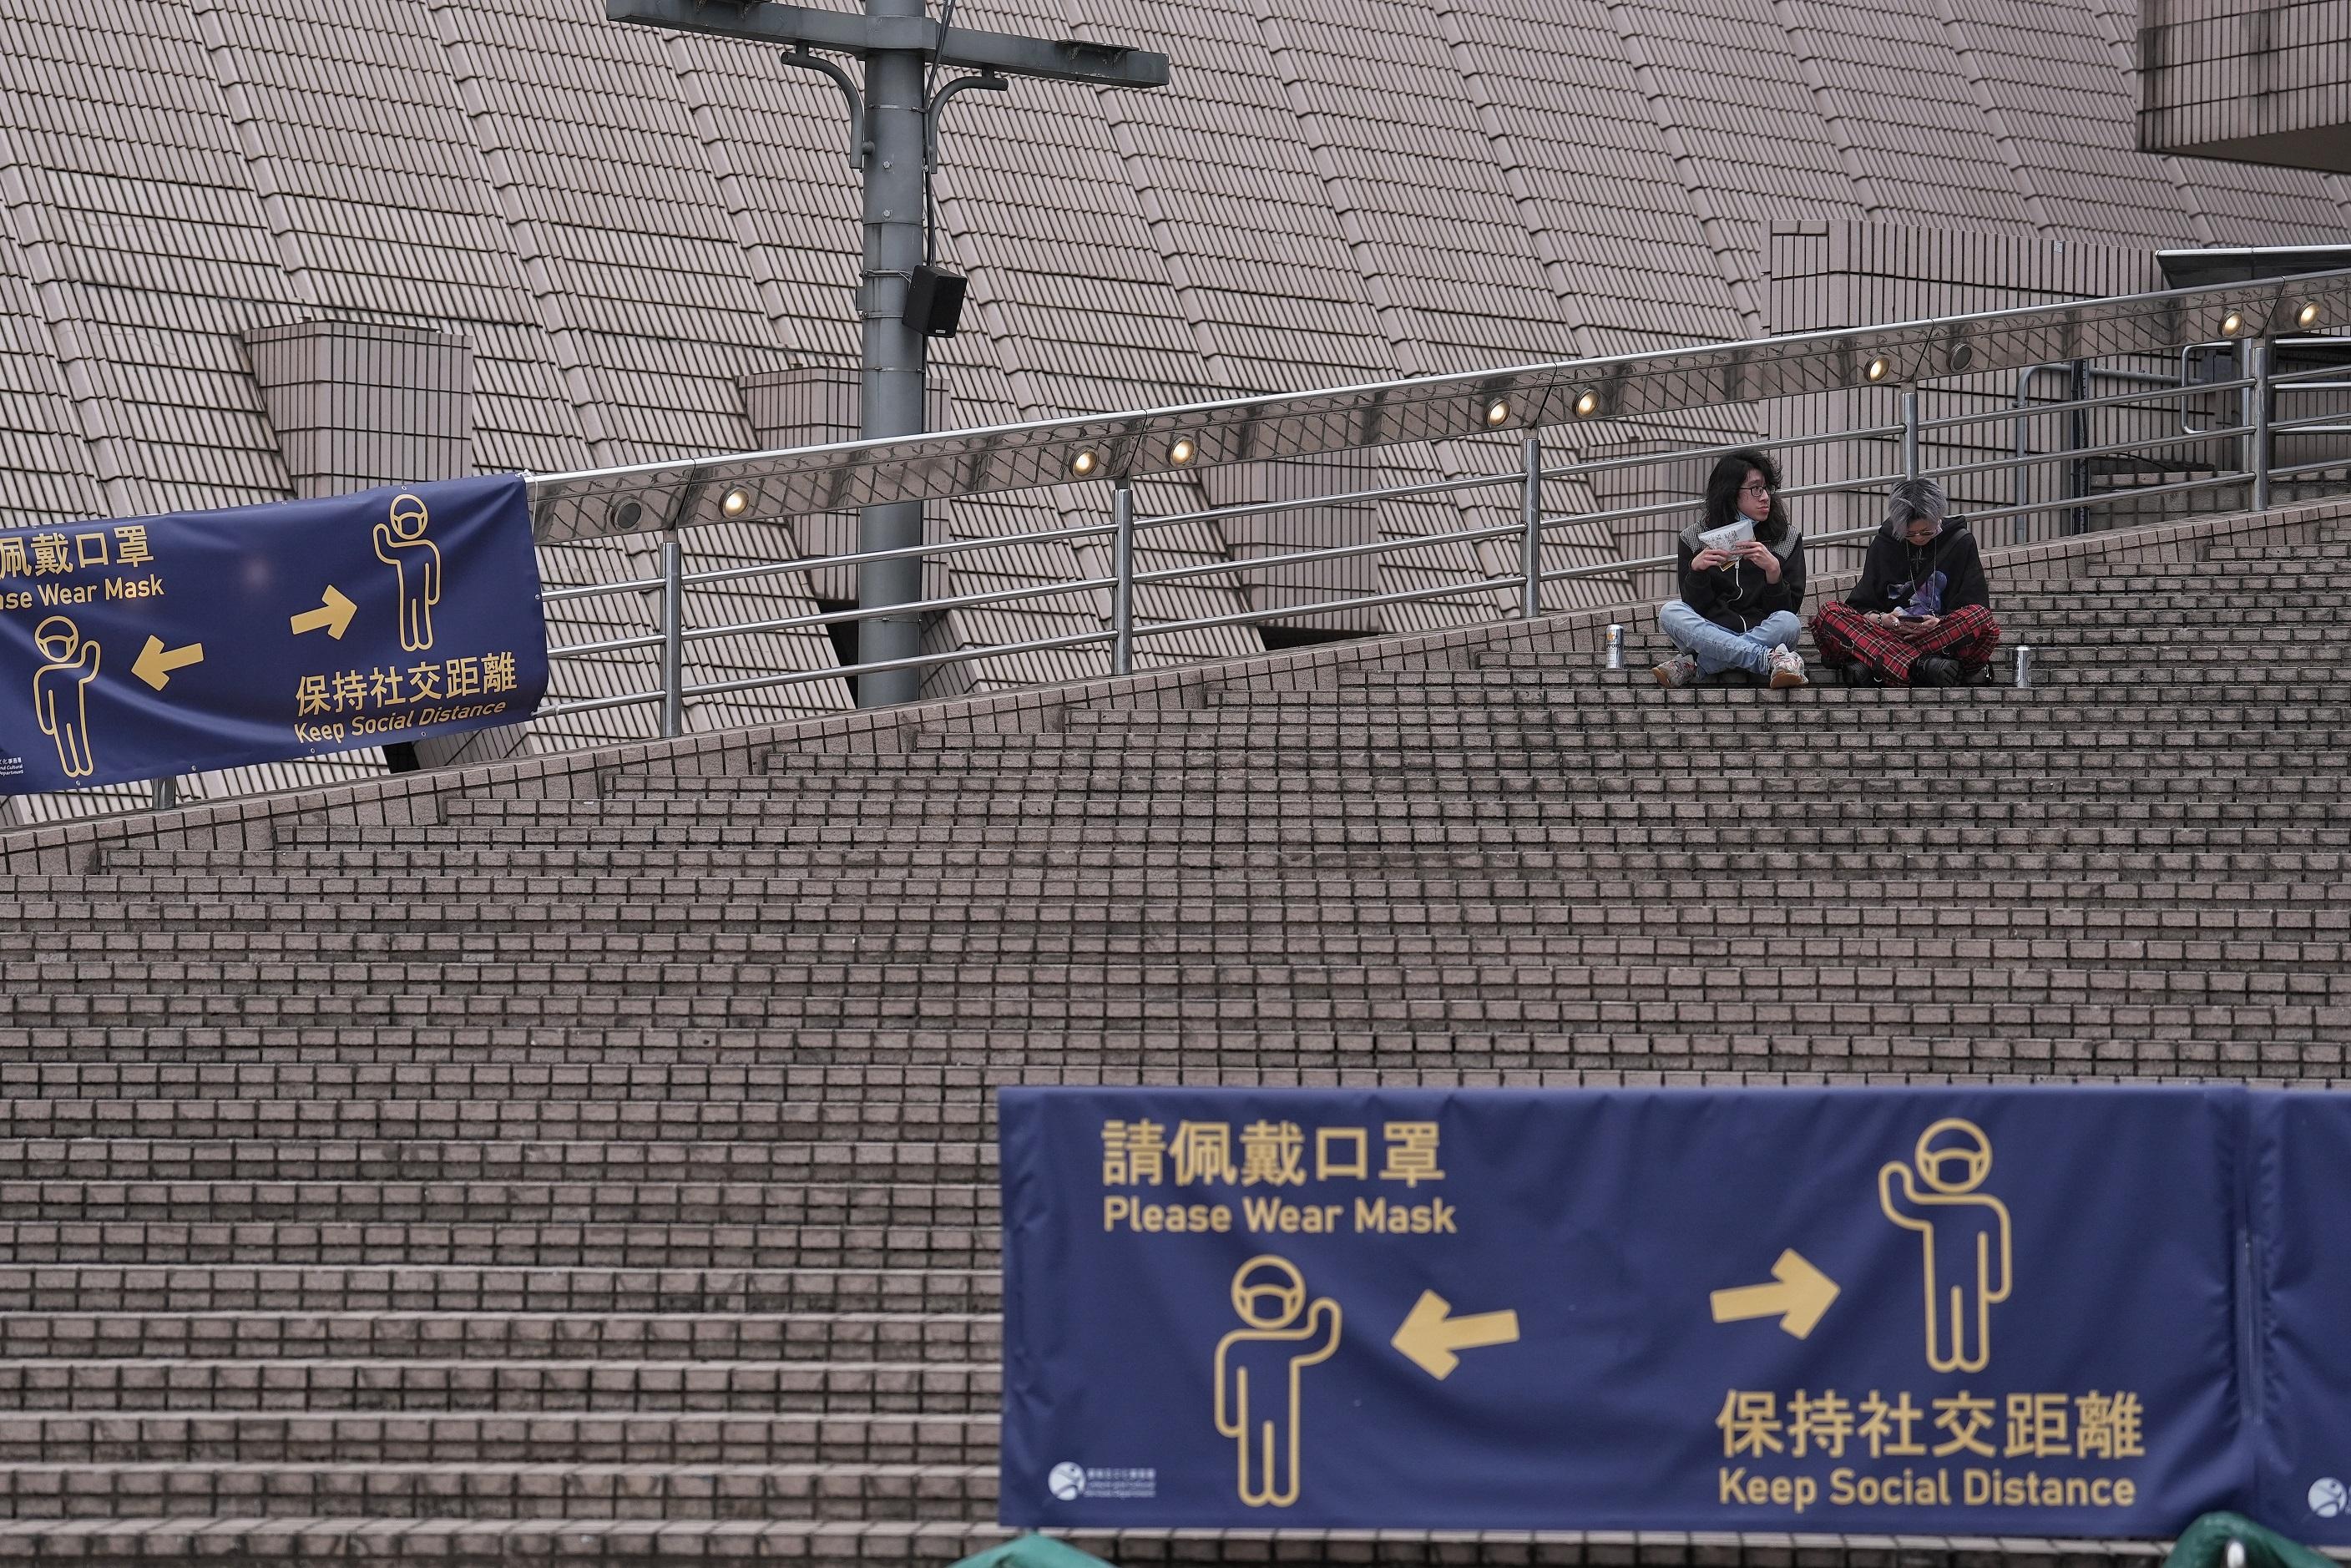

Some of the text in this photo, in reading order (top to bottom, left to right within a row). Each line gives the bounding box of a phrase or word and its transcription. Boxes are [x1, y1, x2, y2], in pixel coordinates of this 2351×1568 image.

[37, 583, 98, 606] Wear
[104, 574, 165, 600] Mask
[295, 651, 518, 717] 保持社交距離
[294, 701, 507, 744] Keep Social Distance
[1101, 1118, 1446, 1188] 請佩戴口罩
[1103, 1195, 1458, 1234] Please Wear Mask
[1715, 1388, 2146, 1459] 保持社交距離
[1718, 1467, 2136, 1514] Keep Social Distance
